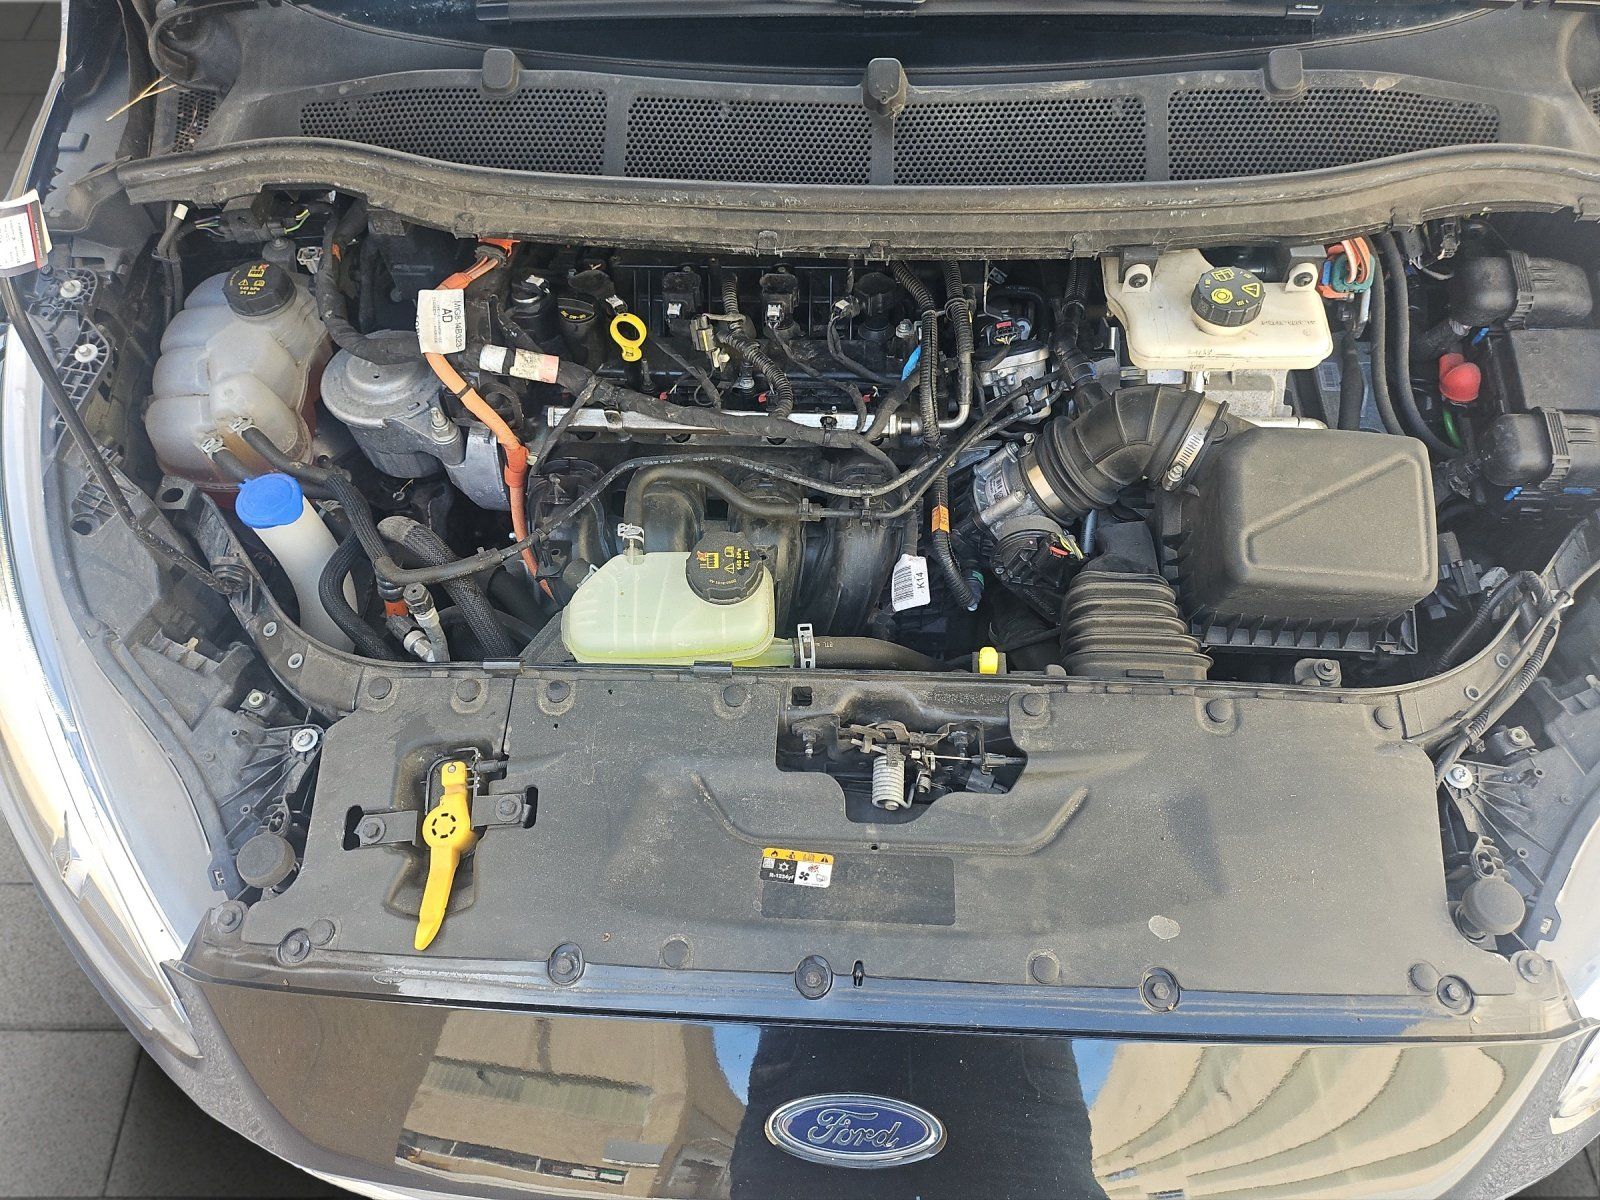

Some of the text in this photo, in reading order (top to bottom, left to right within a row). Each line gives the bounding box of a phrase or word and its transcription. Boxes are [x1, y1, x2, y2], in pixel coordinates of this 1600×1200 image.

[441, 308, 453, 323] AD
[916, 572, 925, 589] K14
[807, 1108, 902, 1147] Ford
